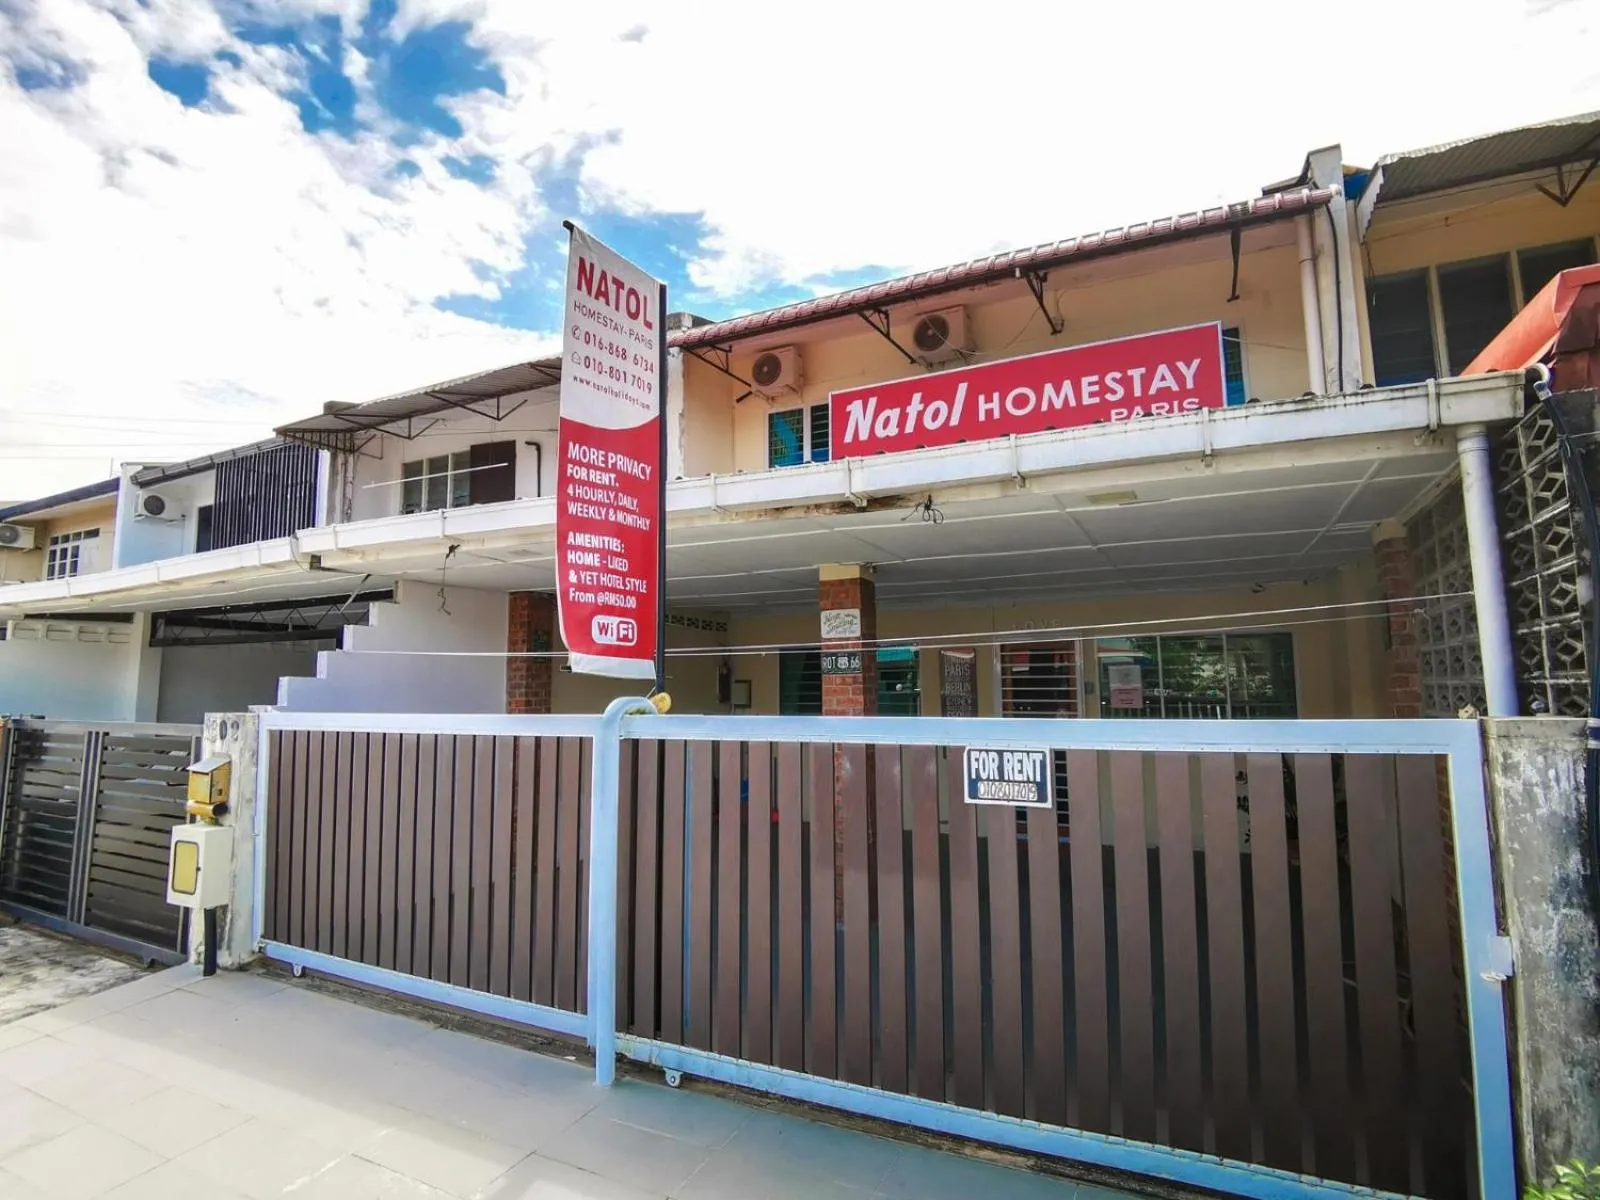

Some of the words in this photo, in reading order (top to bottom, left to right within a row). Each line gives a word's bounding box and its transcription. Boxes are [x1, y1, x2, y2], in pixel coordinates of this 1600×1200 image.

[577, 256, 653, 331] NATOL
[584, 331, 627, 361] 016-868
[633, 353, 655, 375] 6734
[584, 355, 627, 384] 010-801
[631, 374, 653, 395] 7019
[843, 382, 968, 444] Natol
[978, 358, 1201, 422] HOMESTAY
[1110, 397, 1201, 425] PARIS
[567, 441, 606, 468] MORE
[608, 452, 652, 481] PRIVACY
[567, 463, 588, 482] FOR
[589, 468, 620, 488] RENT.
[567, 483, 574, 497] 4
[567, 500, 606, 521] WEEKLY
[609, 508, 616, 522] &
[617, 509, 651, 531] MONTHLY
[567, 549, 600, 567] HOME
[568, 569, 577, 584] &
[580, 570, 598, 586] YET
[600, 572, 624, 591] HOTEL
[625, 577, 648, 594] STYLE
[569, 587, 595, 604] From
[970, 750, 1000, 780] FOR
[1003, 751, 1044, 783] RENT
